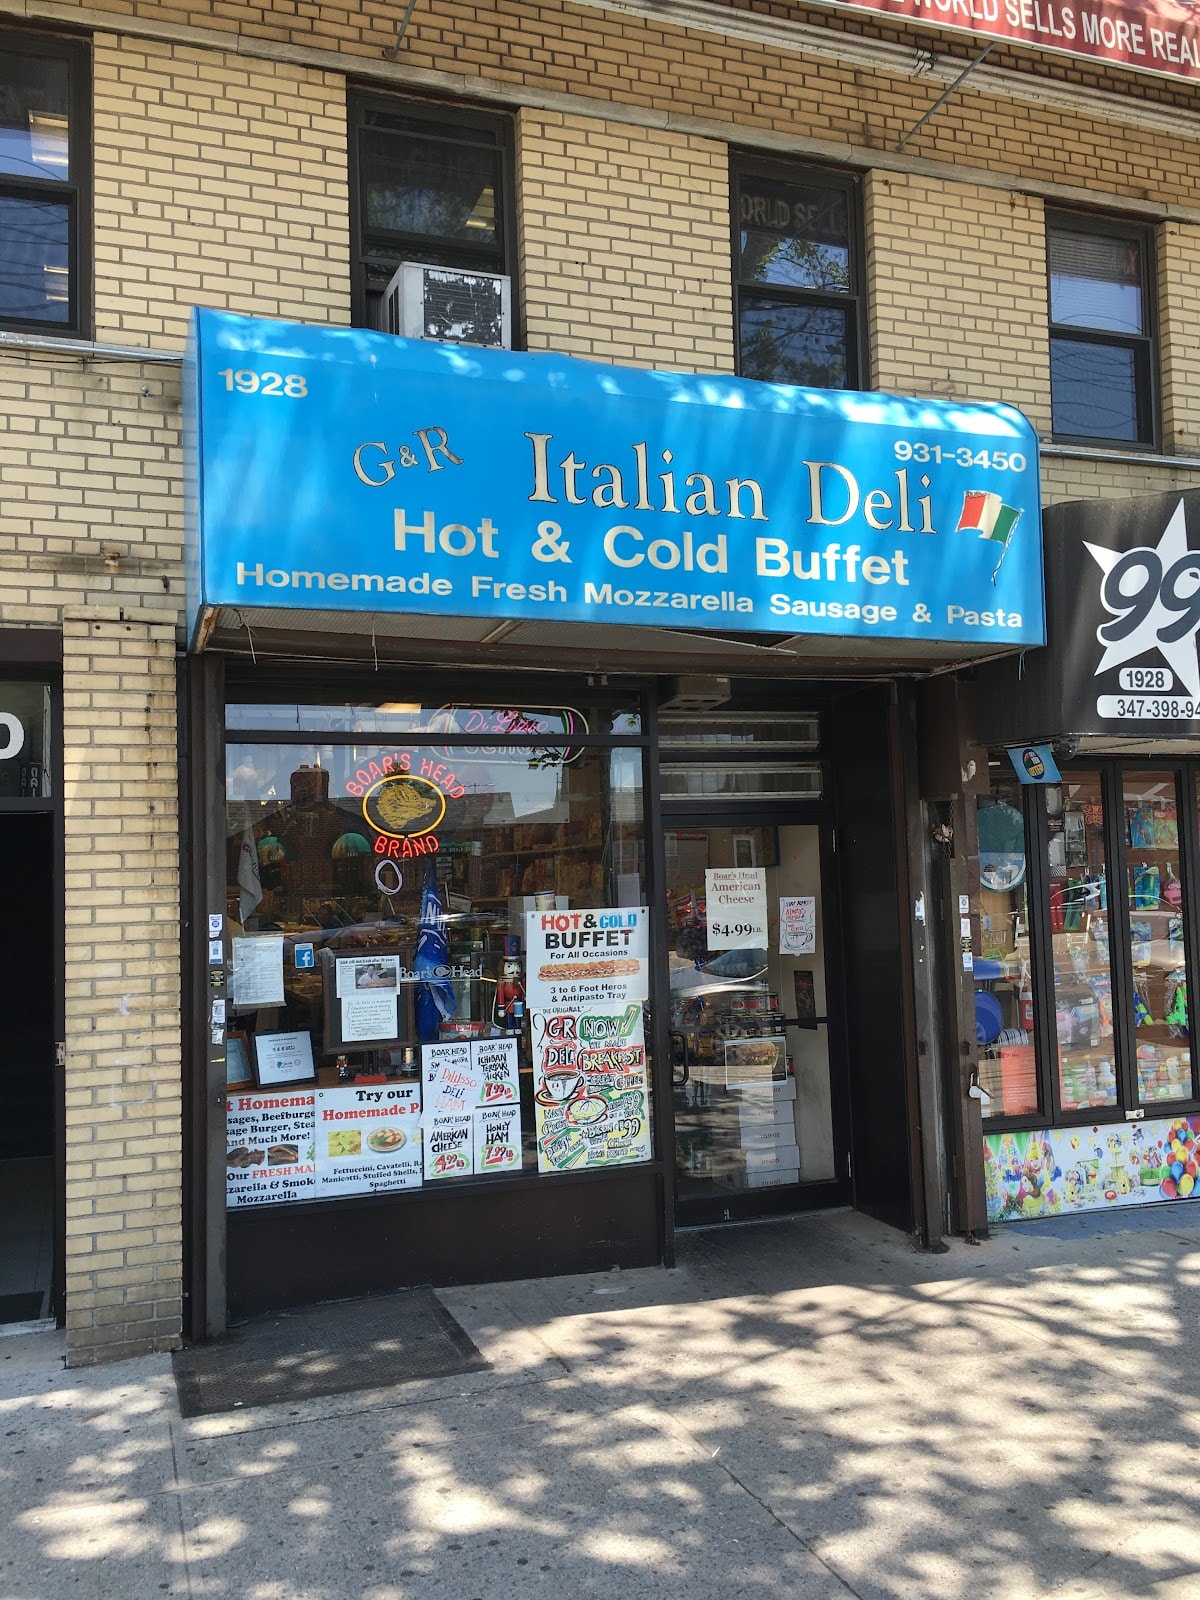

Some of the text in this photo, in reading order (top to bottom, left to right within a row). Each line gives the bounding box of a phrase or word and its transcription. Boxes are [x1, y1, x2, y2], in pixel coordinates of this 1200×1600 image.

[1005, 0, 1076, 39] SELLS
[1082, 11, 1146, 56] MORE
[217, 368, 308, 398] 1928
[353, 425, 464, 488] G&R
[894, 440, 1027, 473] 931-3450
[524, 431, 938, 535] Italian Deli
[394, 508, 909, 586] Hot & Cold Buffet
[237, 562, 1023, 628] Homemade Fresh Mozzarella Sausage & Pasta
[1126, 670, 1165, 689] 1928
[346, 753, 465, 799] BOAR'S HEAD
[374, 835, 439, 858] BRAND
[713, 872, 758, 880] Boar's Head
[711, 882, 760, 892] American
[718, 894, 754, 904] Cheese
[712, 922, 752, 936] $4.99
[545, 929, 634, 949] BUFFET
[568, 951, 580, 959] All
[582, 949, 628, 957] Occasions
[400, 965, 483, 979] Boar's Head
[550, 983, 627, 994] 3 to 6 Foot Heros
[561, 993, 605, 1002] Antipasto
[607, 992, 627, 1000] Tray
[356, 1089, 413, 1103] Try our
[323, 1104, 407, 1121] Homemade
[251, 1123, 291, 1134] Burger,
[486, 1121, 511, 1133] HONEY
[248, 1135, 277, 1145] Much
[280, 1131, 310, 1142] More!
[486, 1131, 509, 1145] HAM
[432, 1141, 463, 1153] CHEESE
[252, 1167, 292, 1179] FRESH
[295, 1164, 315, 1175] MA
[333, 1165, 375, 1175] Fettuccini,
[376, 1161, 413, 1171] Cavatelli,
[322, 1168, 418, 1183] Manicotti, Stuffed Shells,
[270, 1181, 280, 1190] &
[281, 1177, 315, 1188] Smok
[369, 1178, 406, 1188] Spaghetti
[237, 1191, 298, 1205] Mozzarella
